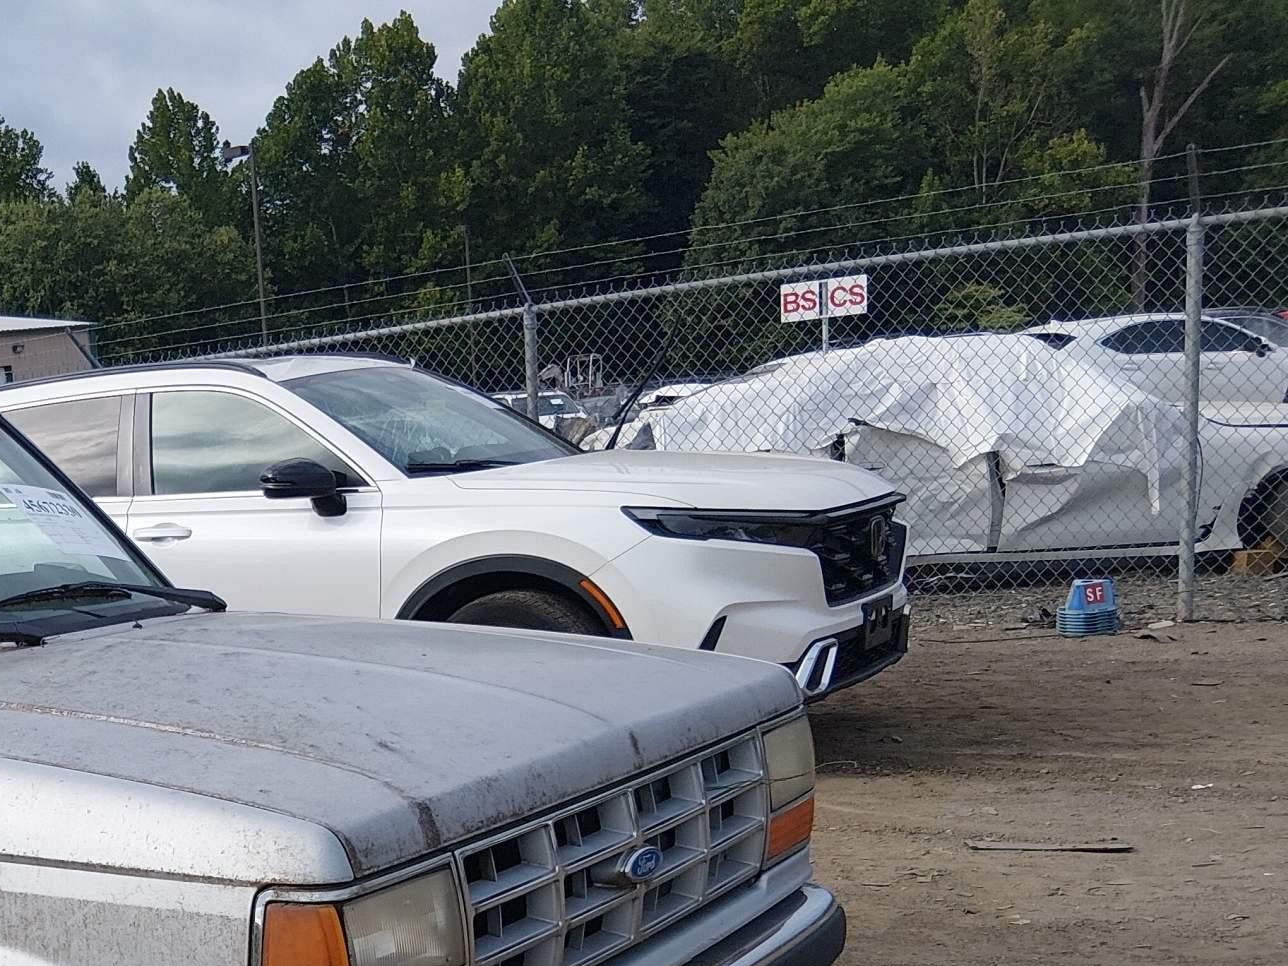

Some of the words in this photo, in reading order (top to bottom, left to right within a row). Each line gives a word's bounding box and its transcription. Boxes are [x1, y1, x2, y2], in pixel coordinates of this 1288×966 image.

[782, 290, 818, 314] BS
[829, 284, 866, 308] CS
[1085, 586, 1103, 602] SF
